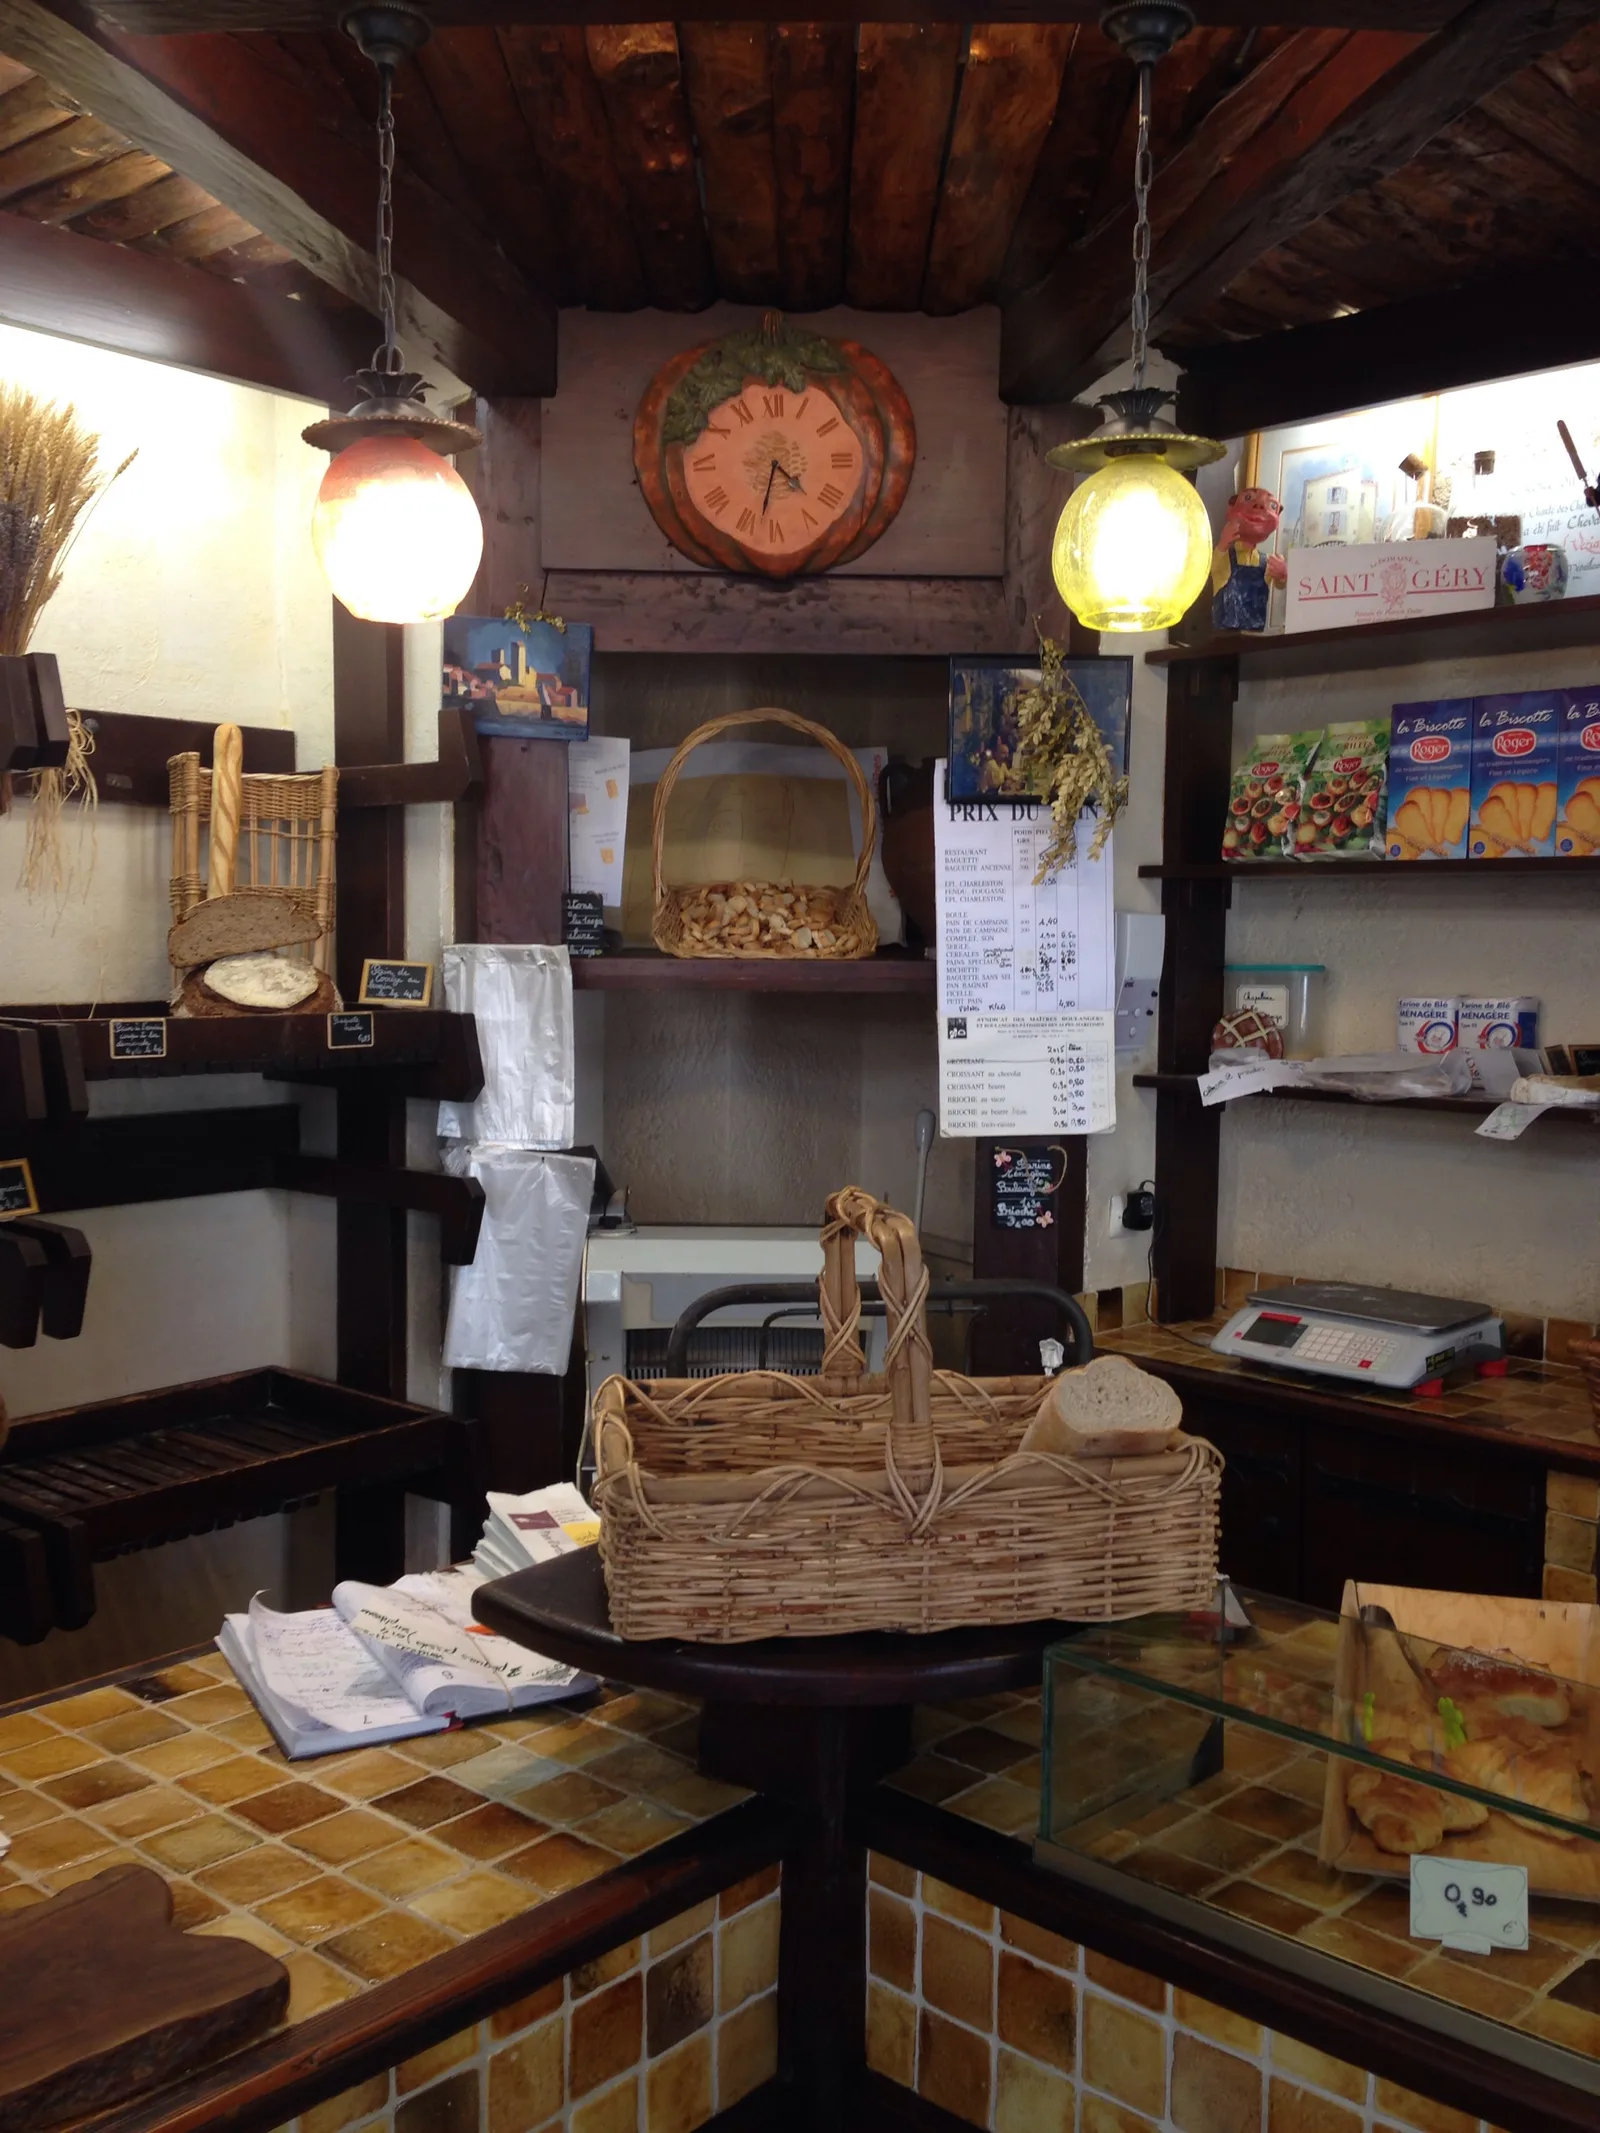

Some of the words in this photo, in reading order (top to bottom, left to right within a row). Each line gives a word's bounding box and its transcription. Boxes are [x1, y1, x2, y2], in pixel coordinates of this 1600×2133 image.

[763, 394, 784, 418] XII
[1378, 555, 1414, 565] DOMAINE
[1299, 573, 1375, 596] SAINT
[1412, 563, 1490, 590] GÉRY
[1479, 712, 1492, 727] la
[1496, 709, 1554, 726] Biscotte
[1567, 704, 1581, 720] la
[1397, 720, 1410, 734] la
[1413, 717, 1467, 732] Biscotte
[1414, 741, 1448, 759] Roger
[1497, 735, 1533, 753] Roger
[1253, 764, 1279, 775] Roger
[1335, 759, 1360, 774] Roger
[950, 804, 999, 822] PRIX
[1011, 804, 1039, 821] DU
[1434, 1000, 1448, 1008] Blé
[1461, 1001, 1481, 1009] Farine
[1461, 1010, 1510, 1020] MÉNAGÈRE
[997, 1202, 1038, 1216] Brioche
